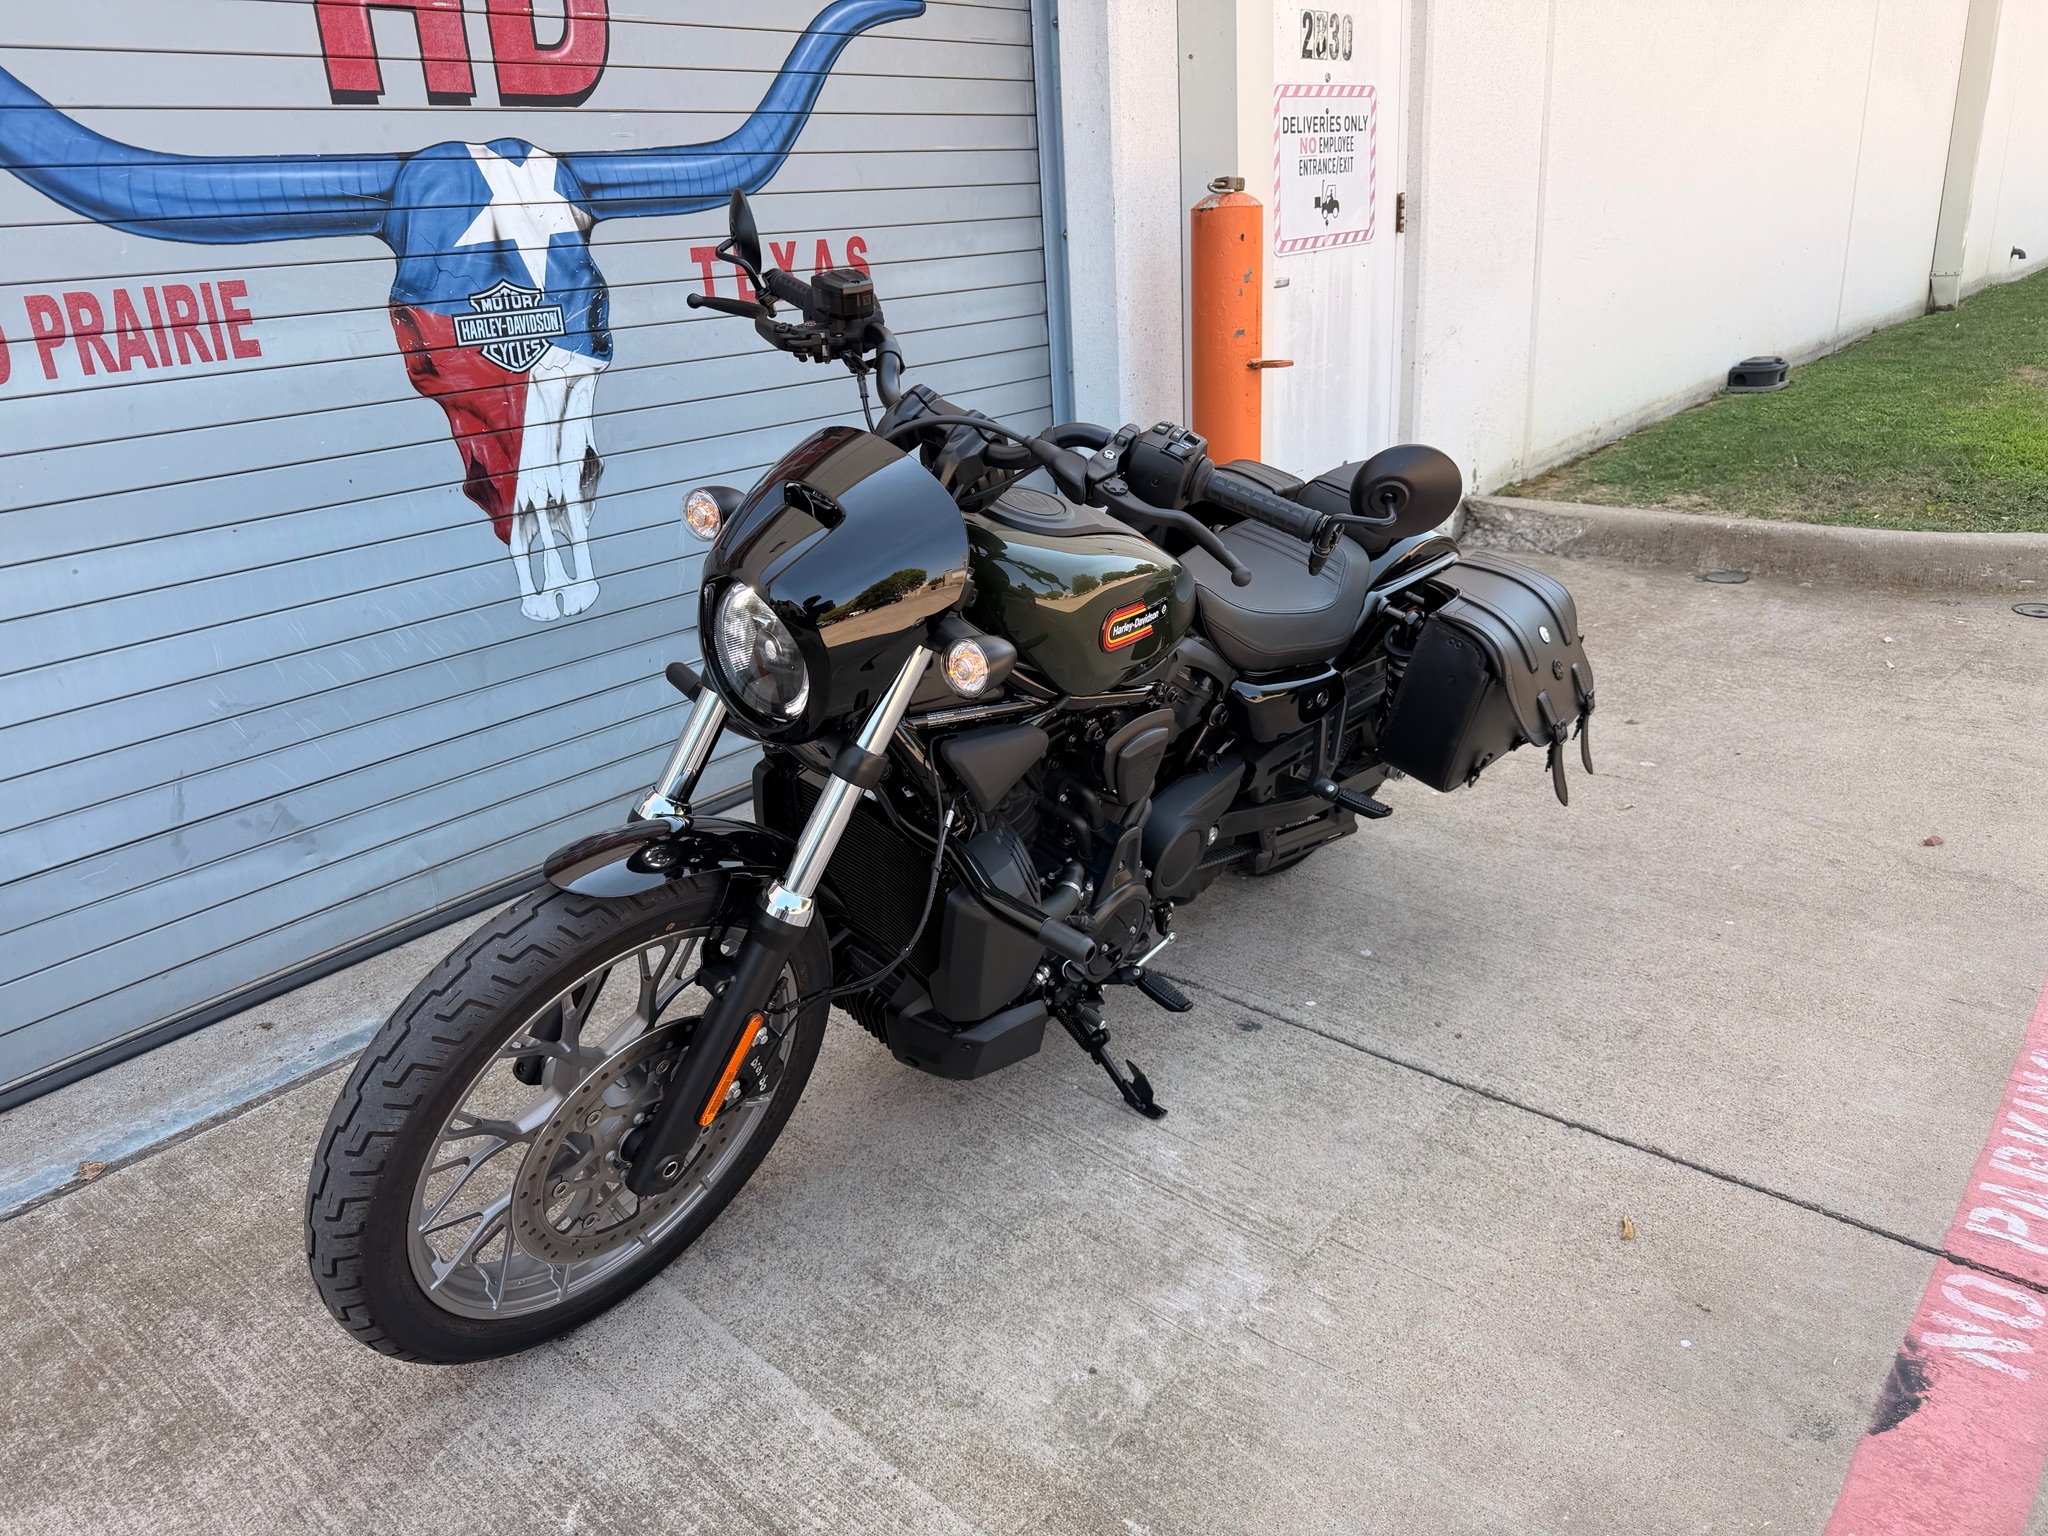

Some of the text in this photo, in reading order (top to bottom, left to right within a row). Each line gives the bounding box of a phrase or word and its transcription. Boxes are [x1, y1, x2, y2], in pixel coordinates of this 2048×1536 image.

[1301, 11, 1353, 61] 2830
[1282, 115, 1369, 134] DELIVERIES ONLY
[1299, 136, 1354, 154] NO EMPLOYEE
[1299, 156, 1354, 176] ENTRANCE/EXIT
[481, 287, 533, 312] MOTOR
[24, 280, 262, 380] PRAIRIE
[461, 311, 560, 340] HARLEY-DAVIDSON
[489, 339, 542, 368] CYCLES
[1112, 610, 1159, 637] Harley-Davidson
[750, 1055, 769, 1091] brebo
[1921, 1273, 2047, 1380] NO
